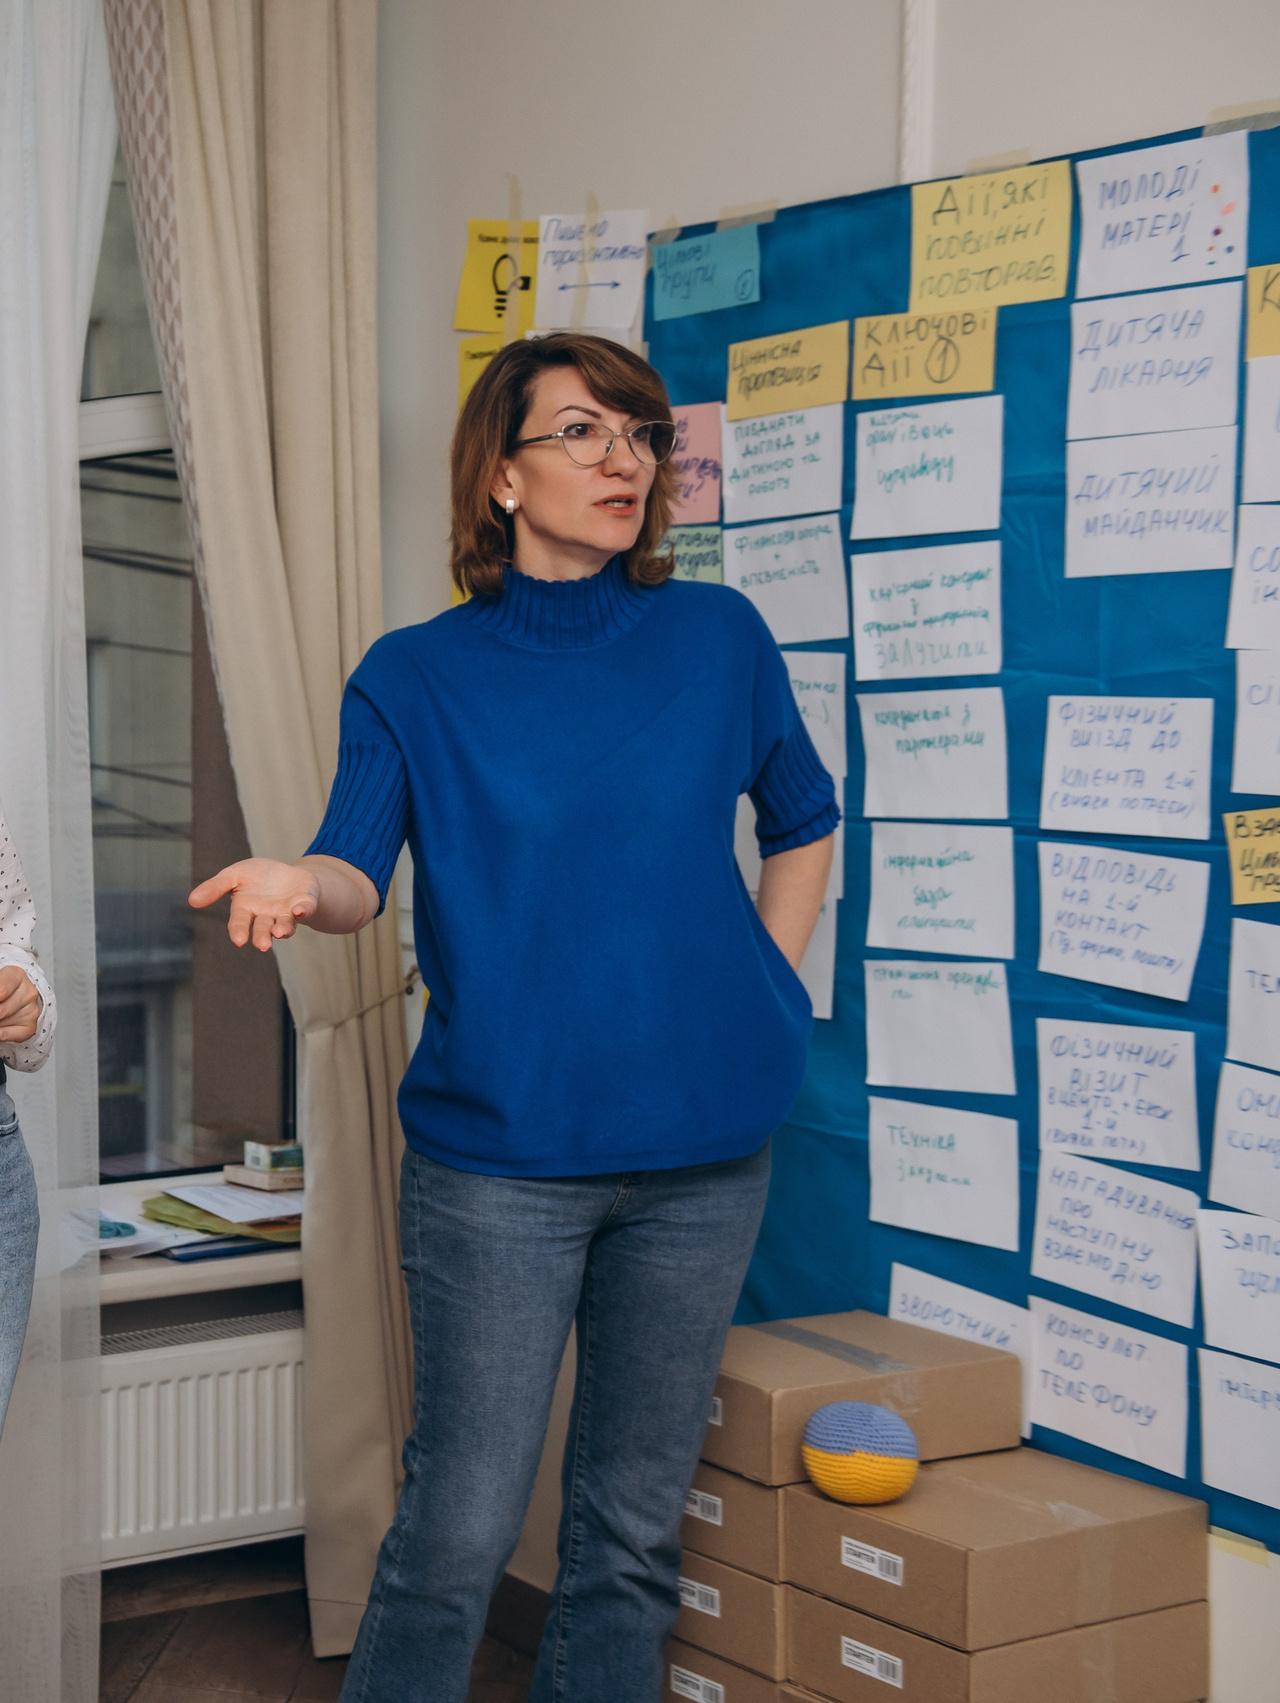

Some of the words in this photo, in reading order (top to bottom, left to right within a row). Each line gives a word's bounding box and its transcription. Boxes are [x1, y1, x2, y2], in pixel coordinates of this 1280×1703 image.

[1078, 308, 1205, 359] ДИТЯЧА
[1089, 356, 1213, 394] ЛІКАРНЯ
[1074, 454, 1220, 503] ДИТЯЧИЙ
[1084, 508, 1228, 539] МАЙДАНЧИК
[1051, 853, 1176, 895] ВІДПОВІДЬ
[1055, 909, 1150, 940] КОНТАКТ
[1070, 1067, 1150, 1096] ВІЗИТ
[1049, 1167, 1195, 1230] НАГАДУВАННЯ
[1060, 1197, 1093, 1218] ПРО
[1047, 1215, 1153, 1262] НАСТУПНУ
[1040, 1368, 1158, 1427] ТЕЛЕФОНУ
